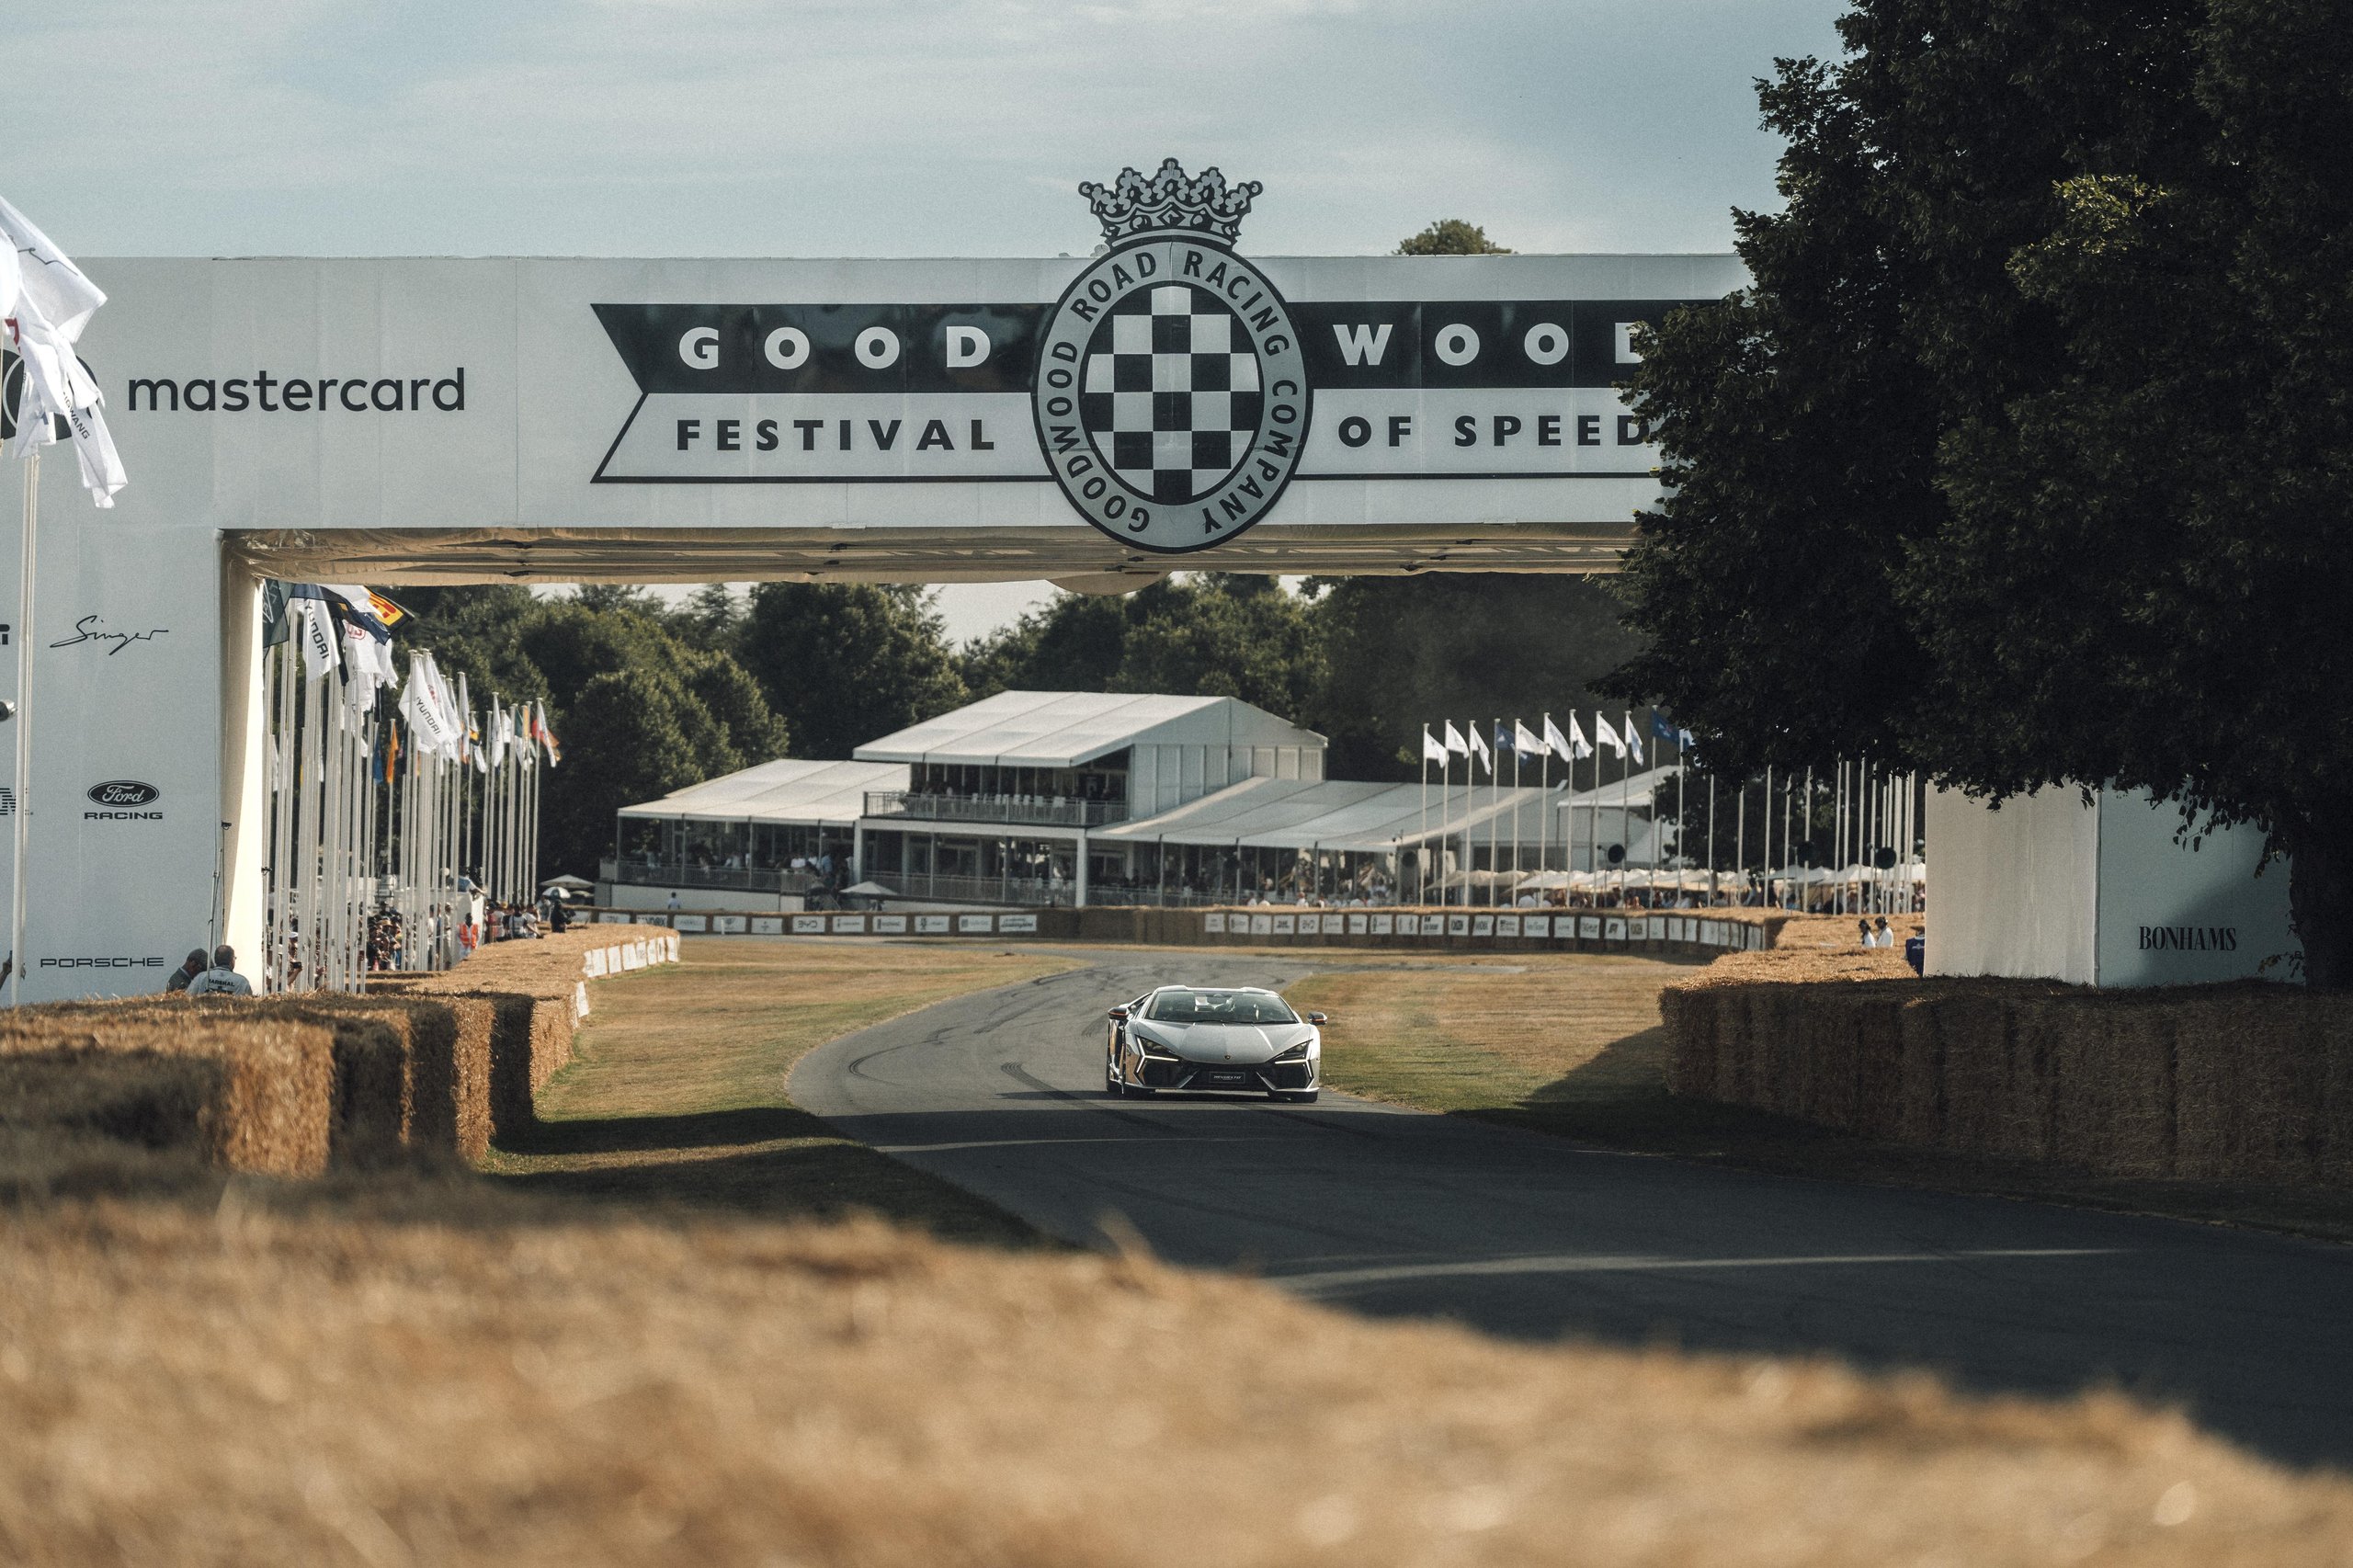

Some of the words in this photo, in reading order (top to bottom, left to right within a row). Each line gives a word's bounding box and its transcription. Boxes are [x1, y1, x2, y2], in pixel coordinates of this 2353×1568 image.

[1070, 252, 1156, 323] ROAD
[1183, 250, 1290, 357] RACING
[678, 326, 991, 369] GOOD
[129, 368, 464, 411] mastercard
[677, 420, 995, 450] FESTIVAL
[1338, 416, 1411, 448] OF
[1455, 415, 1649, 447] SPEED
[1047, 341, 1150, 532] GOODWOOD
[1201, 379, 1298, 534] COMPANY
[50, 616, 168, 655] Singer
[304, 597, 329, 659] YUNDAI
[416, 697, 441, 735] YUNDAI
[102, 783, 146, 803] Ford
[84, 812, 164, 820] RACING
[2139, 926, 2236, 951] BONHAMS
[40, 957, 164, 968] PORSCHE
